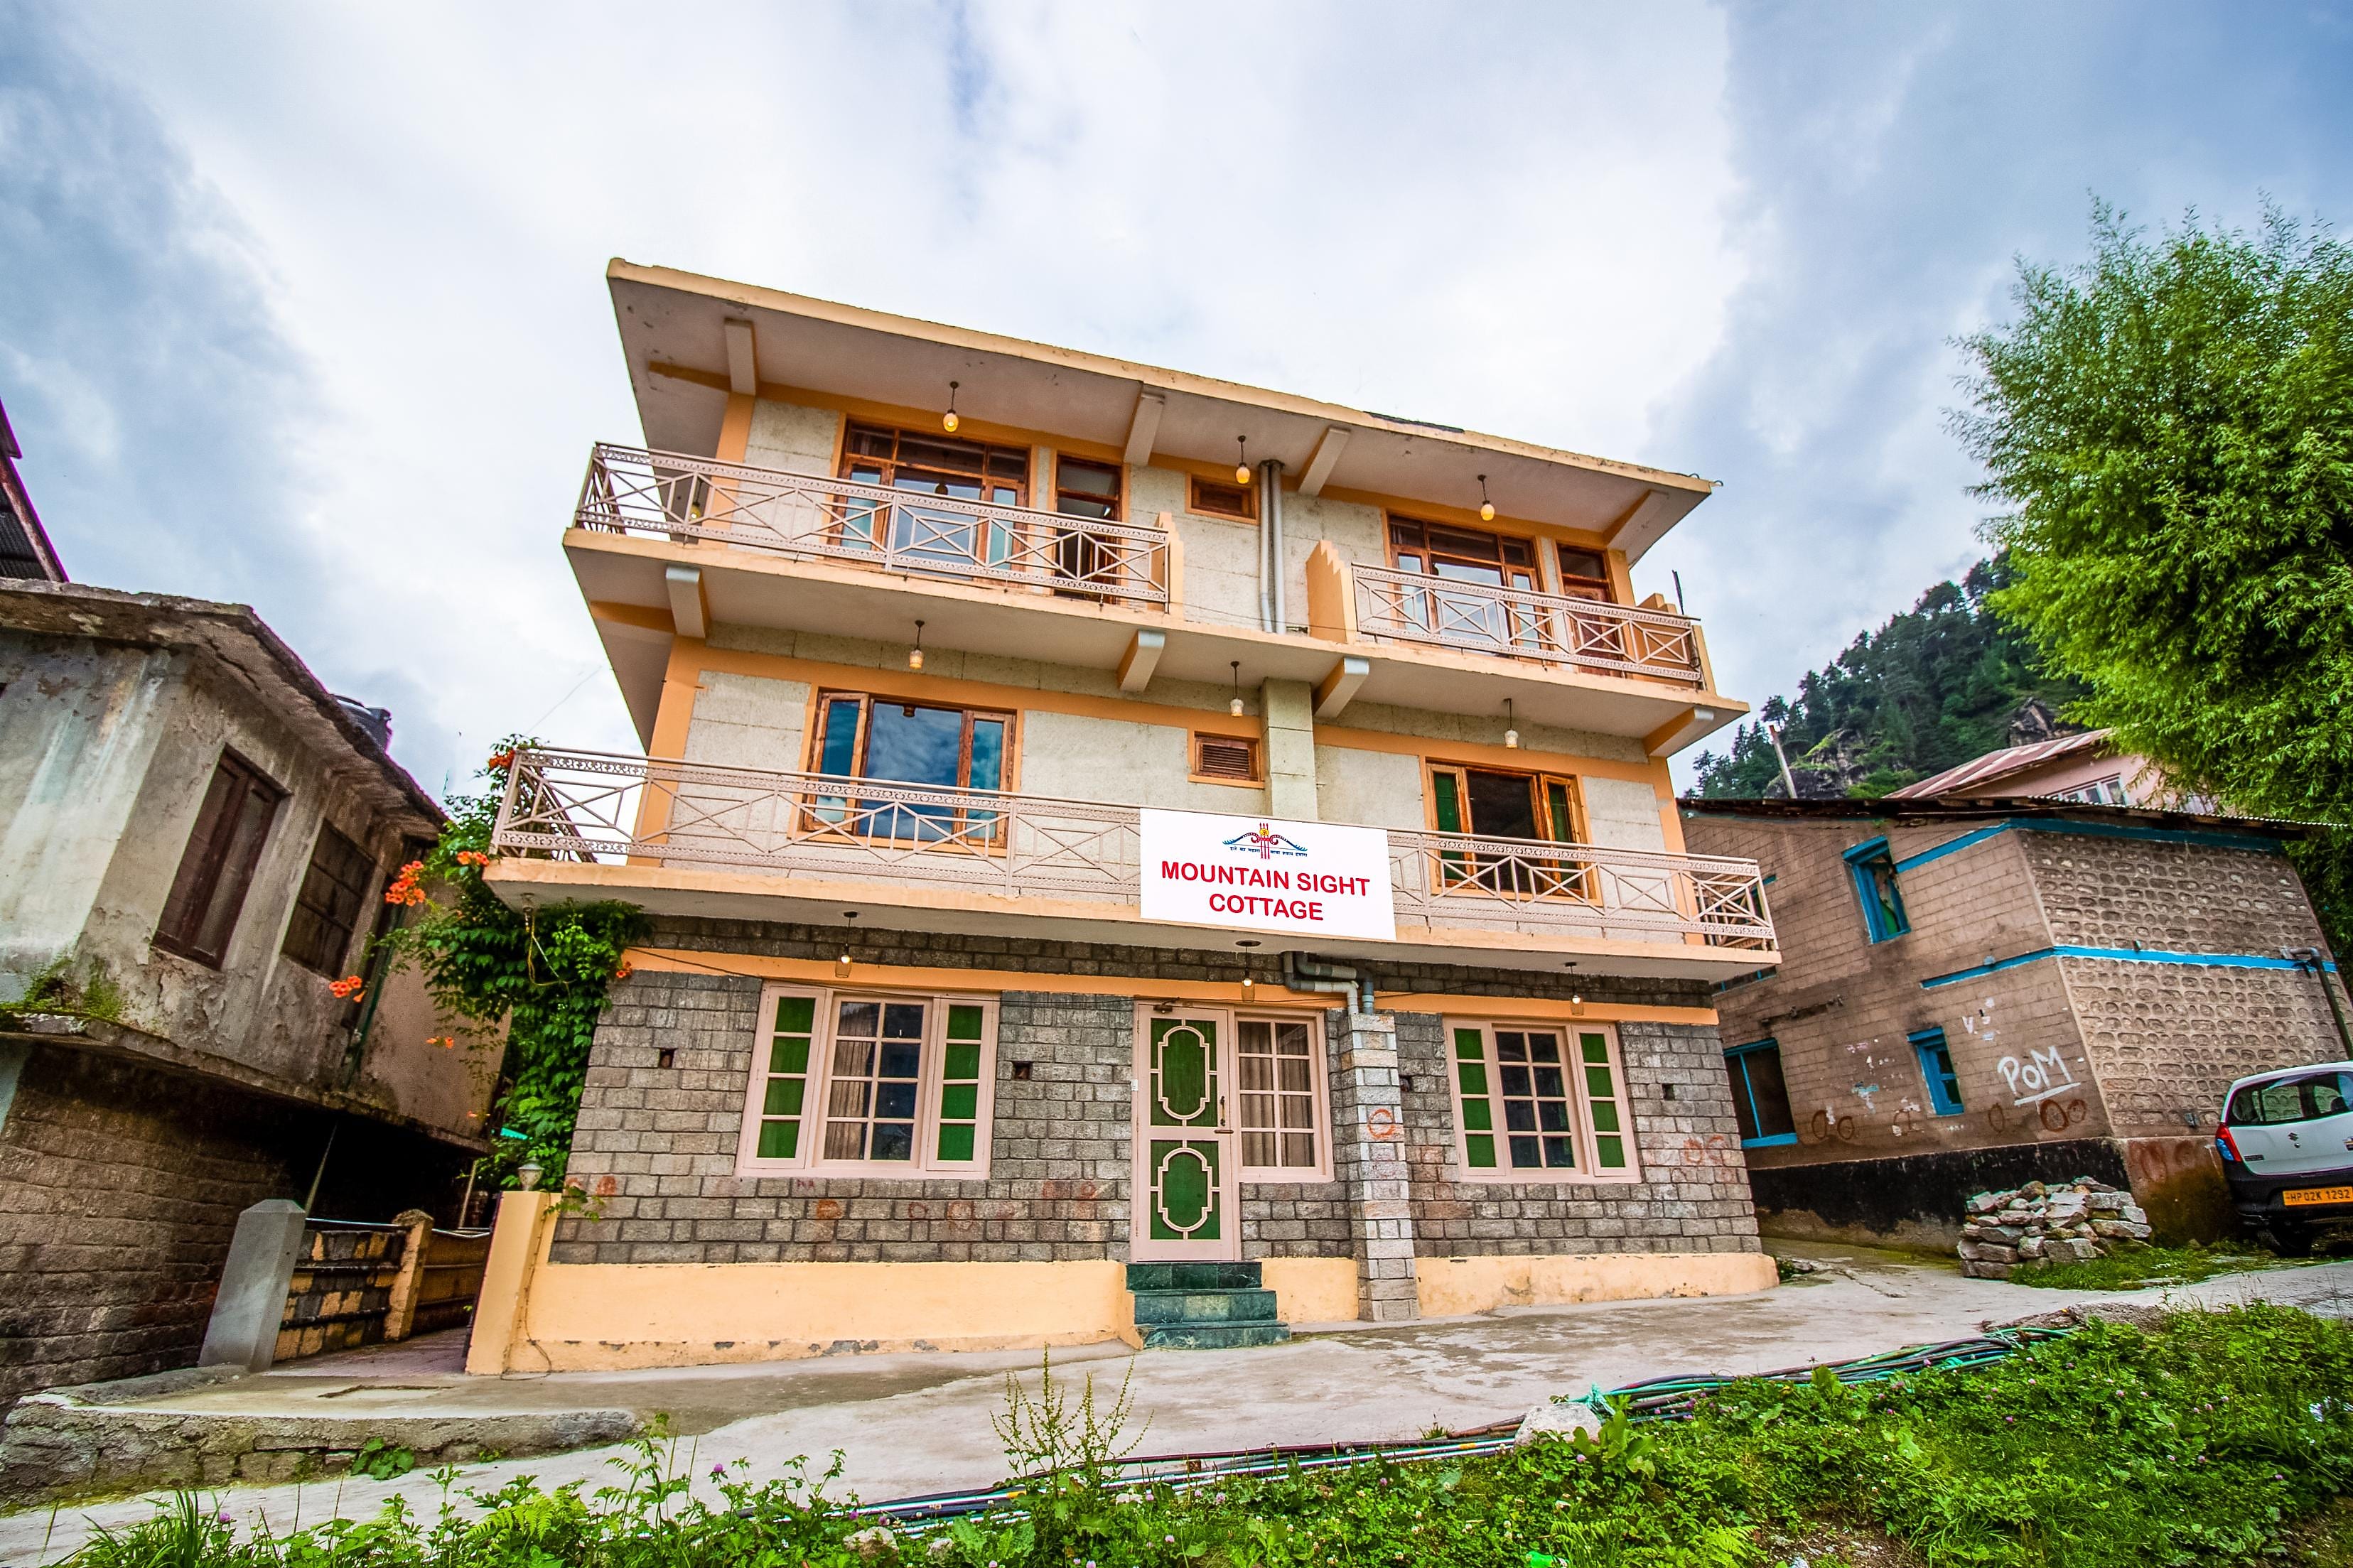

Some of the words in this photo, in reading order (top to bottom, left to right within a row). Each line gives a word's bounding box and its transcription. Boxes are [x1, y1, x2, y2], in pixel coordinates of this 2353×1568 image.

[1162, 860, 1289, 890] MOUNTAIN
[1297, 872, 1370, 897] SIGHT
[1209, 893, 1324, 921] COTTAGE
